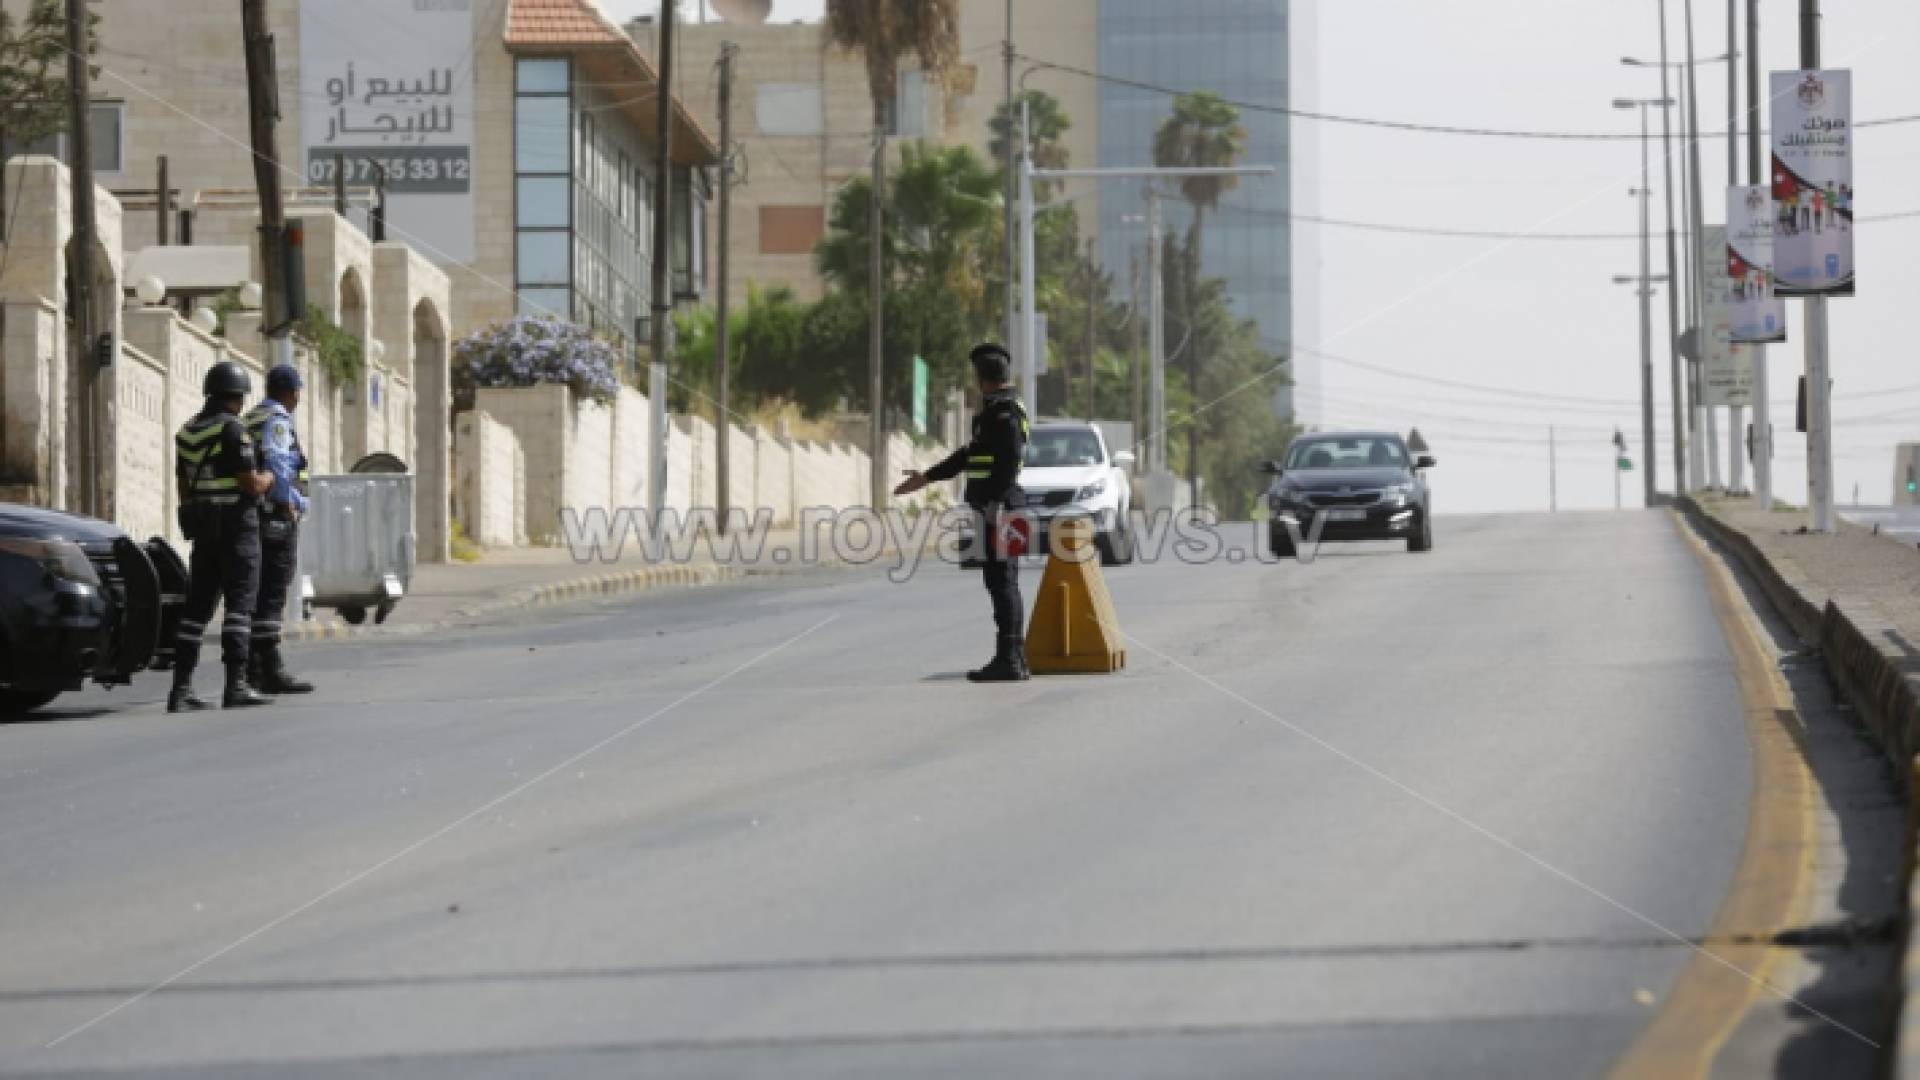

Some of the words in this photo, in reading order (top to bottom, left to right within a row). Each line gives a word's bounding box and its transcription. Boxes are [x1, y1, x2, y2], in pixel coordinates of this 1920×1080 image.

[325, 61, 355, 105] أو
[364, 67, 451, 105] للبيع
[325, 104, 453, 143] للإيجار
[410, 158, 439, 180] 33
[442, 158, 469, 180] 12
